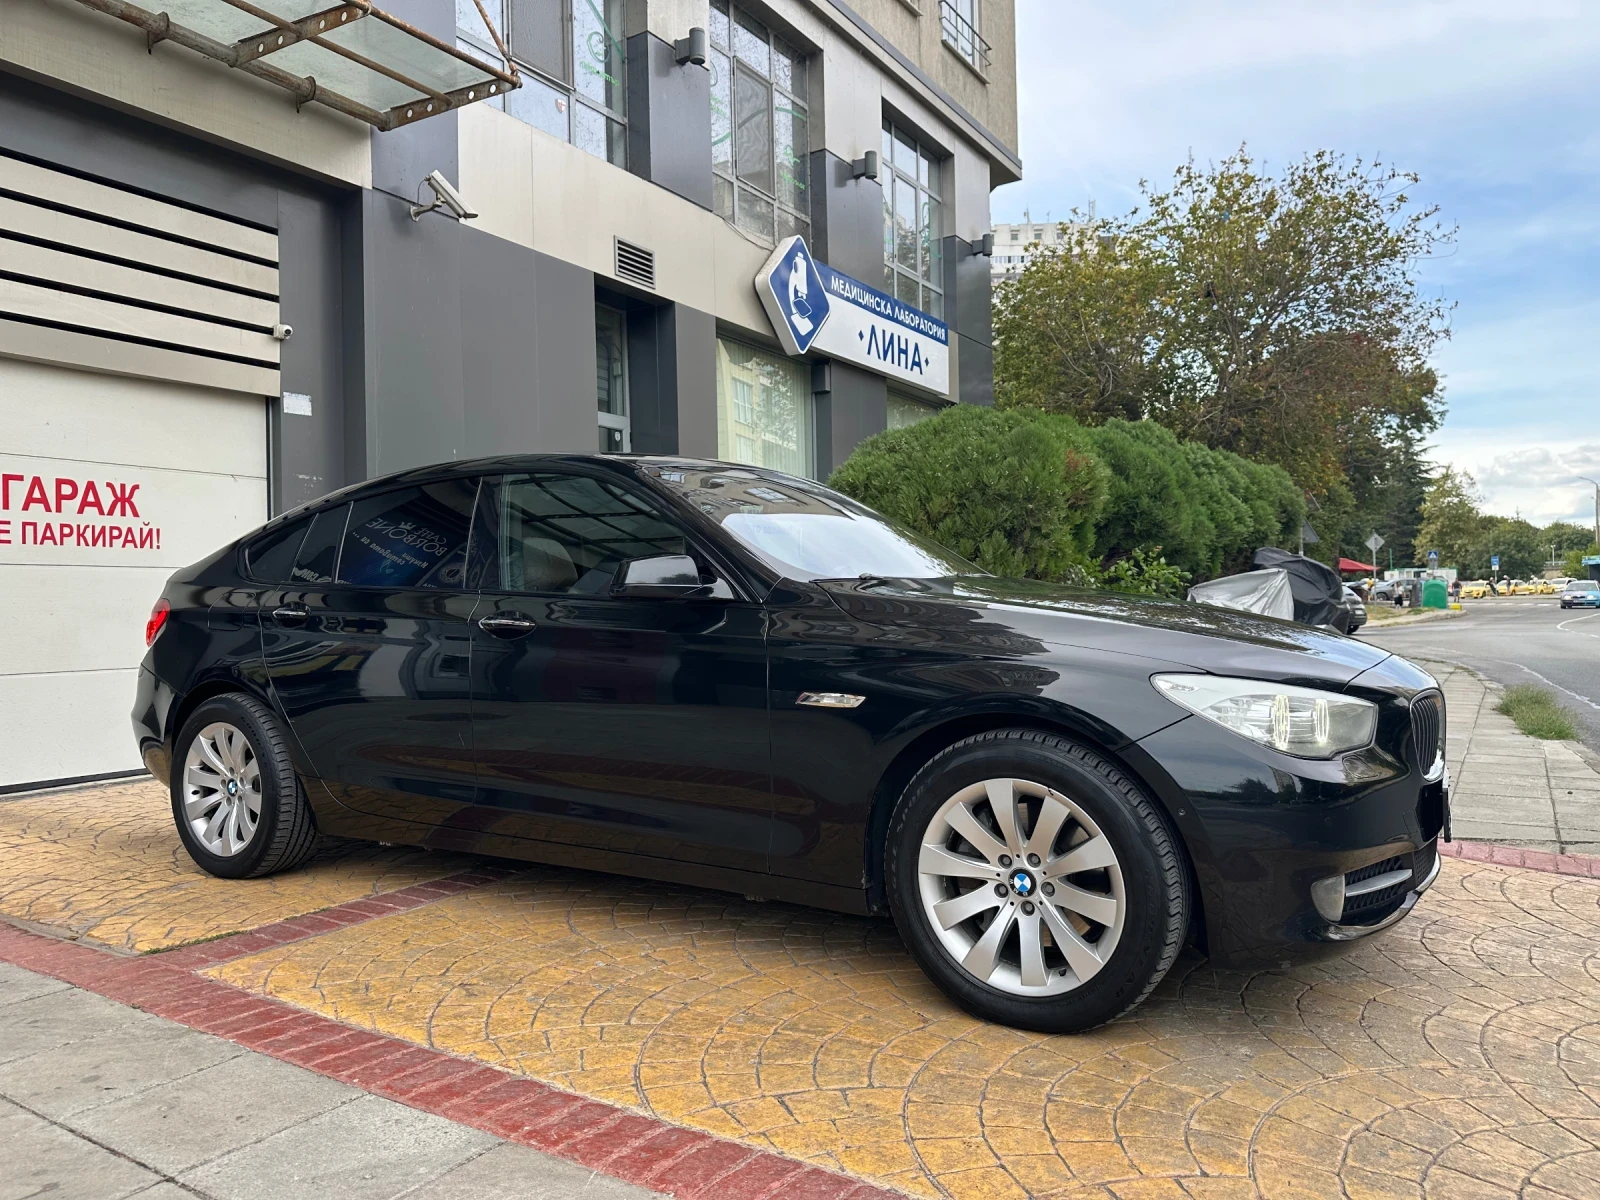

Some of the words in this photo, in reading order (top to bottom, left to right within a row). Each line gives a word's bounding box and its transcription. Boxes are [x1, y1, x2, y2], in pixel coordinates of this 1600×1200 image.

[831, 276, 892, 316] МЕДИЦИНСКА
[894, 307, 945, 341] ЛАБОРАТОРИЯ
[867, 324, 923, 375] ЛИНА
[1, 473, 140, 518] ГАРАЖ
[21, 521, 161, 550] ПАРКИРАЙ!
